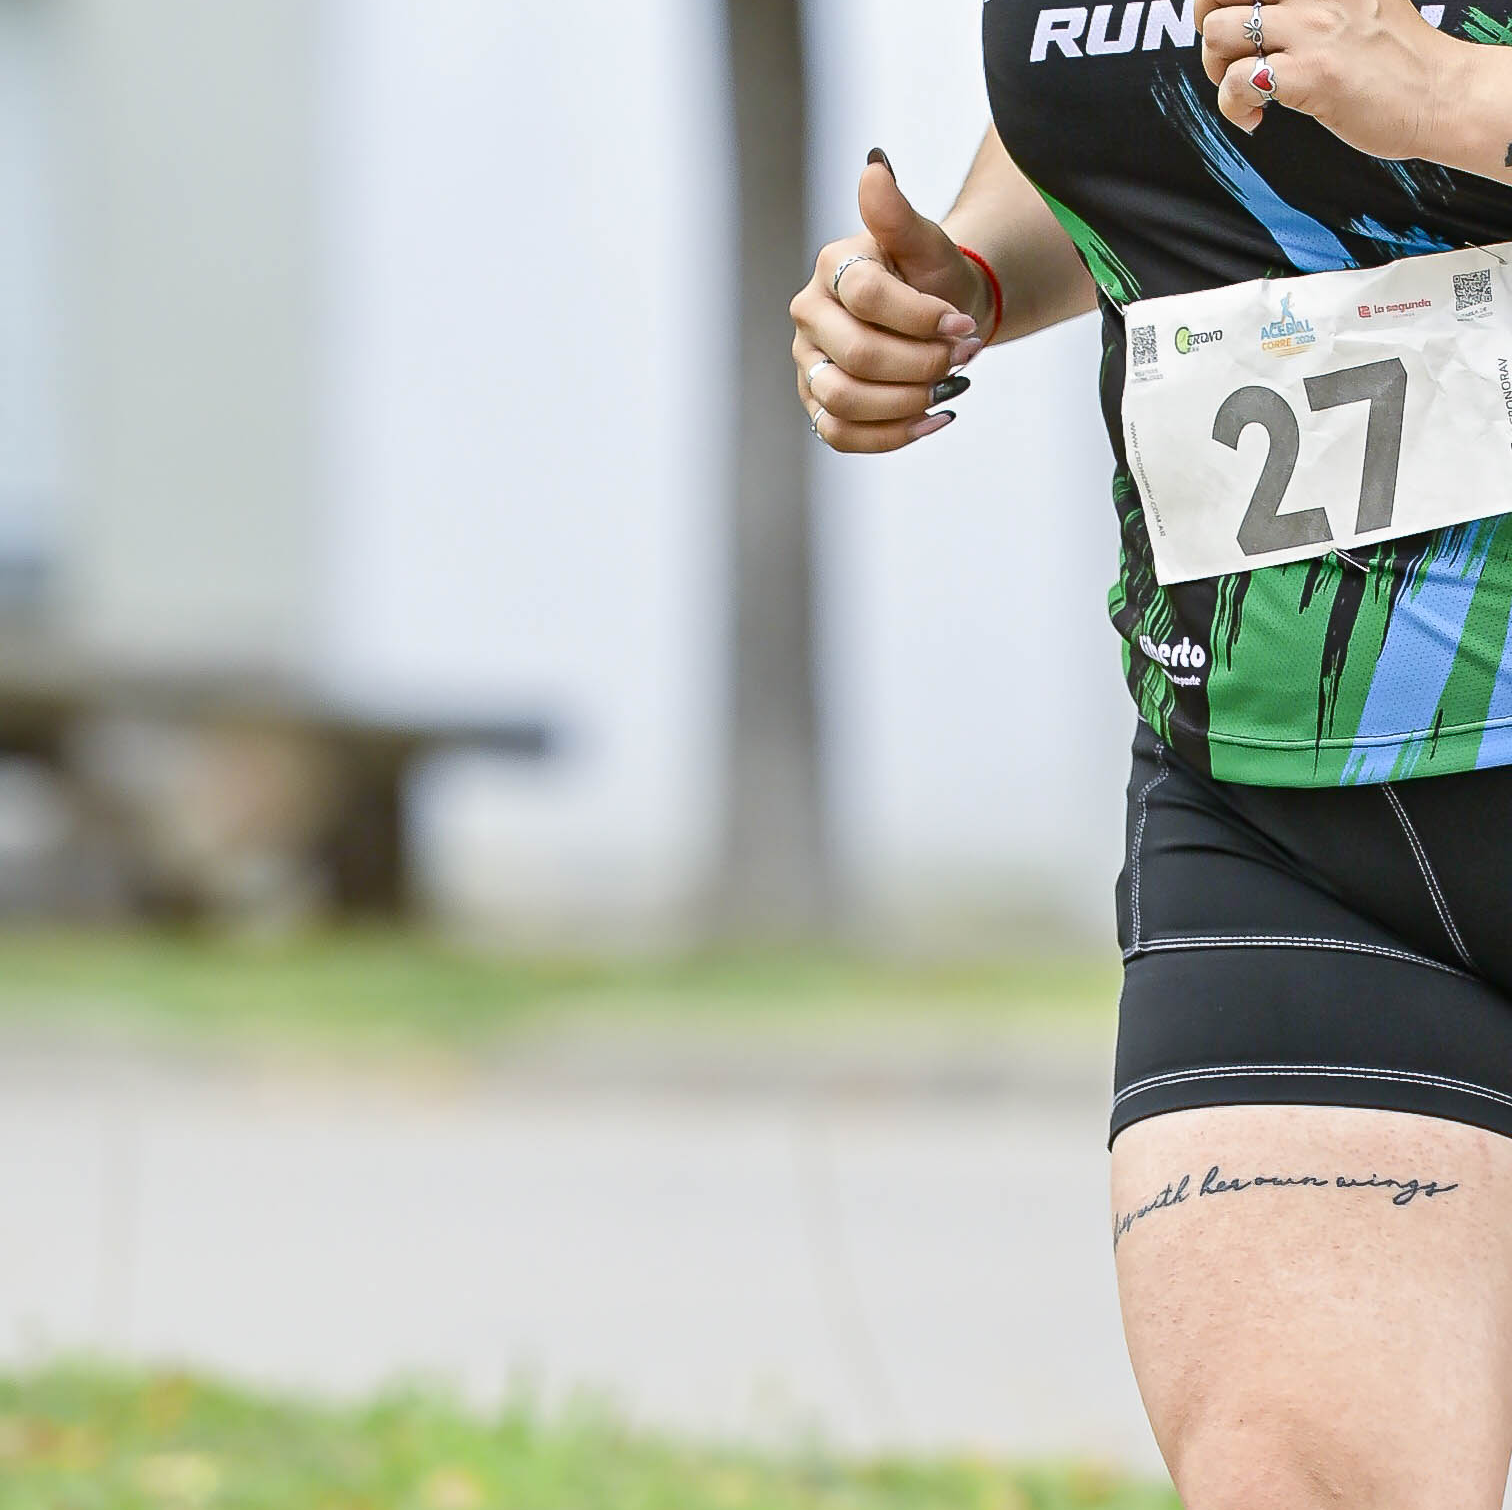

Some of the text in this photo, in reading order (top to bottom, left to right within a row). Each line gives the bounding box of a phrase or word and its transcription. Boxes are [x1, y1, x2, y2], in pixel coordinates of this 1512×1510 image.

[1374, 299, 1432, 314] la segunda
[1212, 357, 1407, 556] 27
[1200, 1166, 1252, 1197] her
[1254, 1176, 1329, 1187] own
[1336, 1173, 1459, 1206] wings
